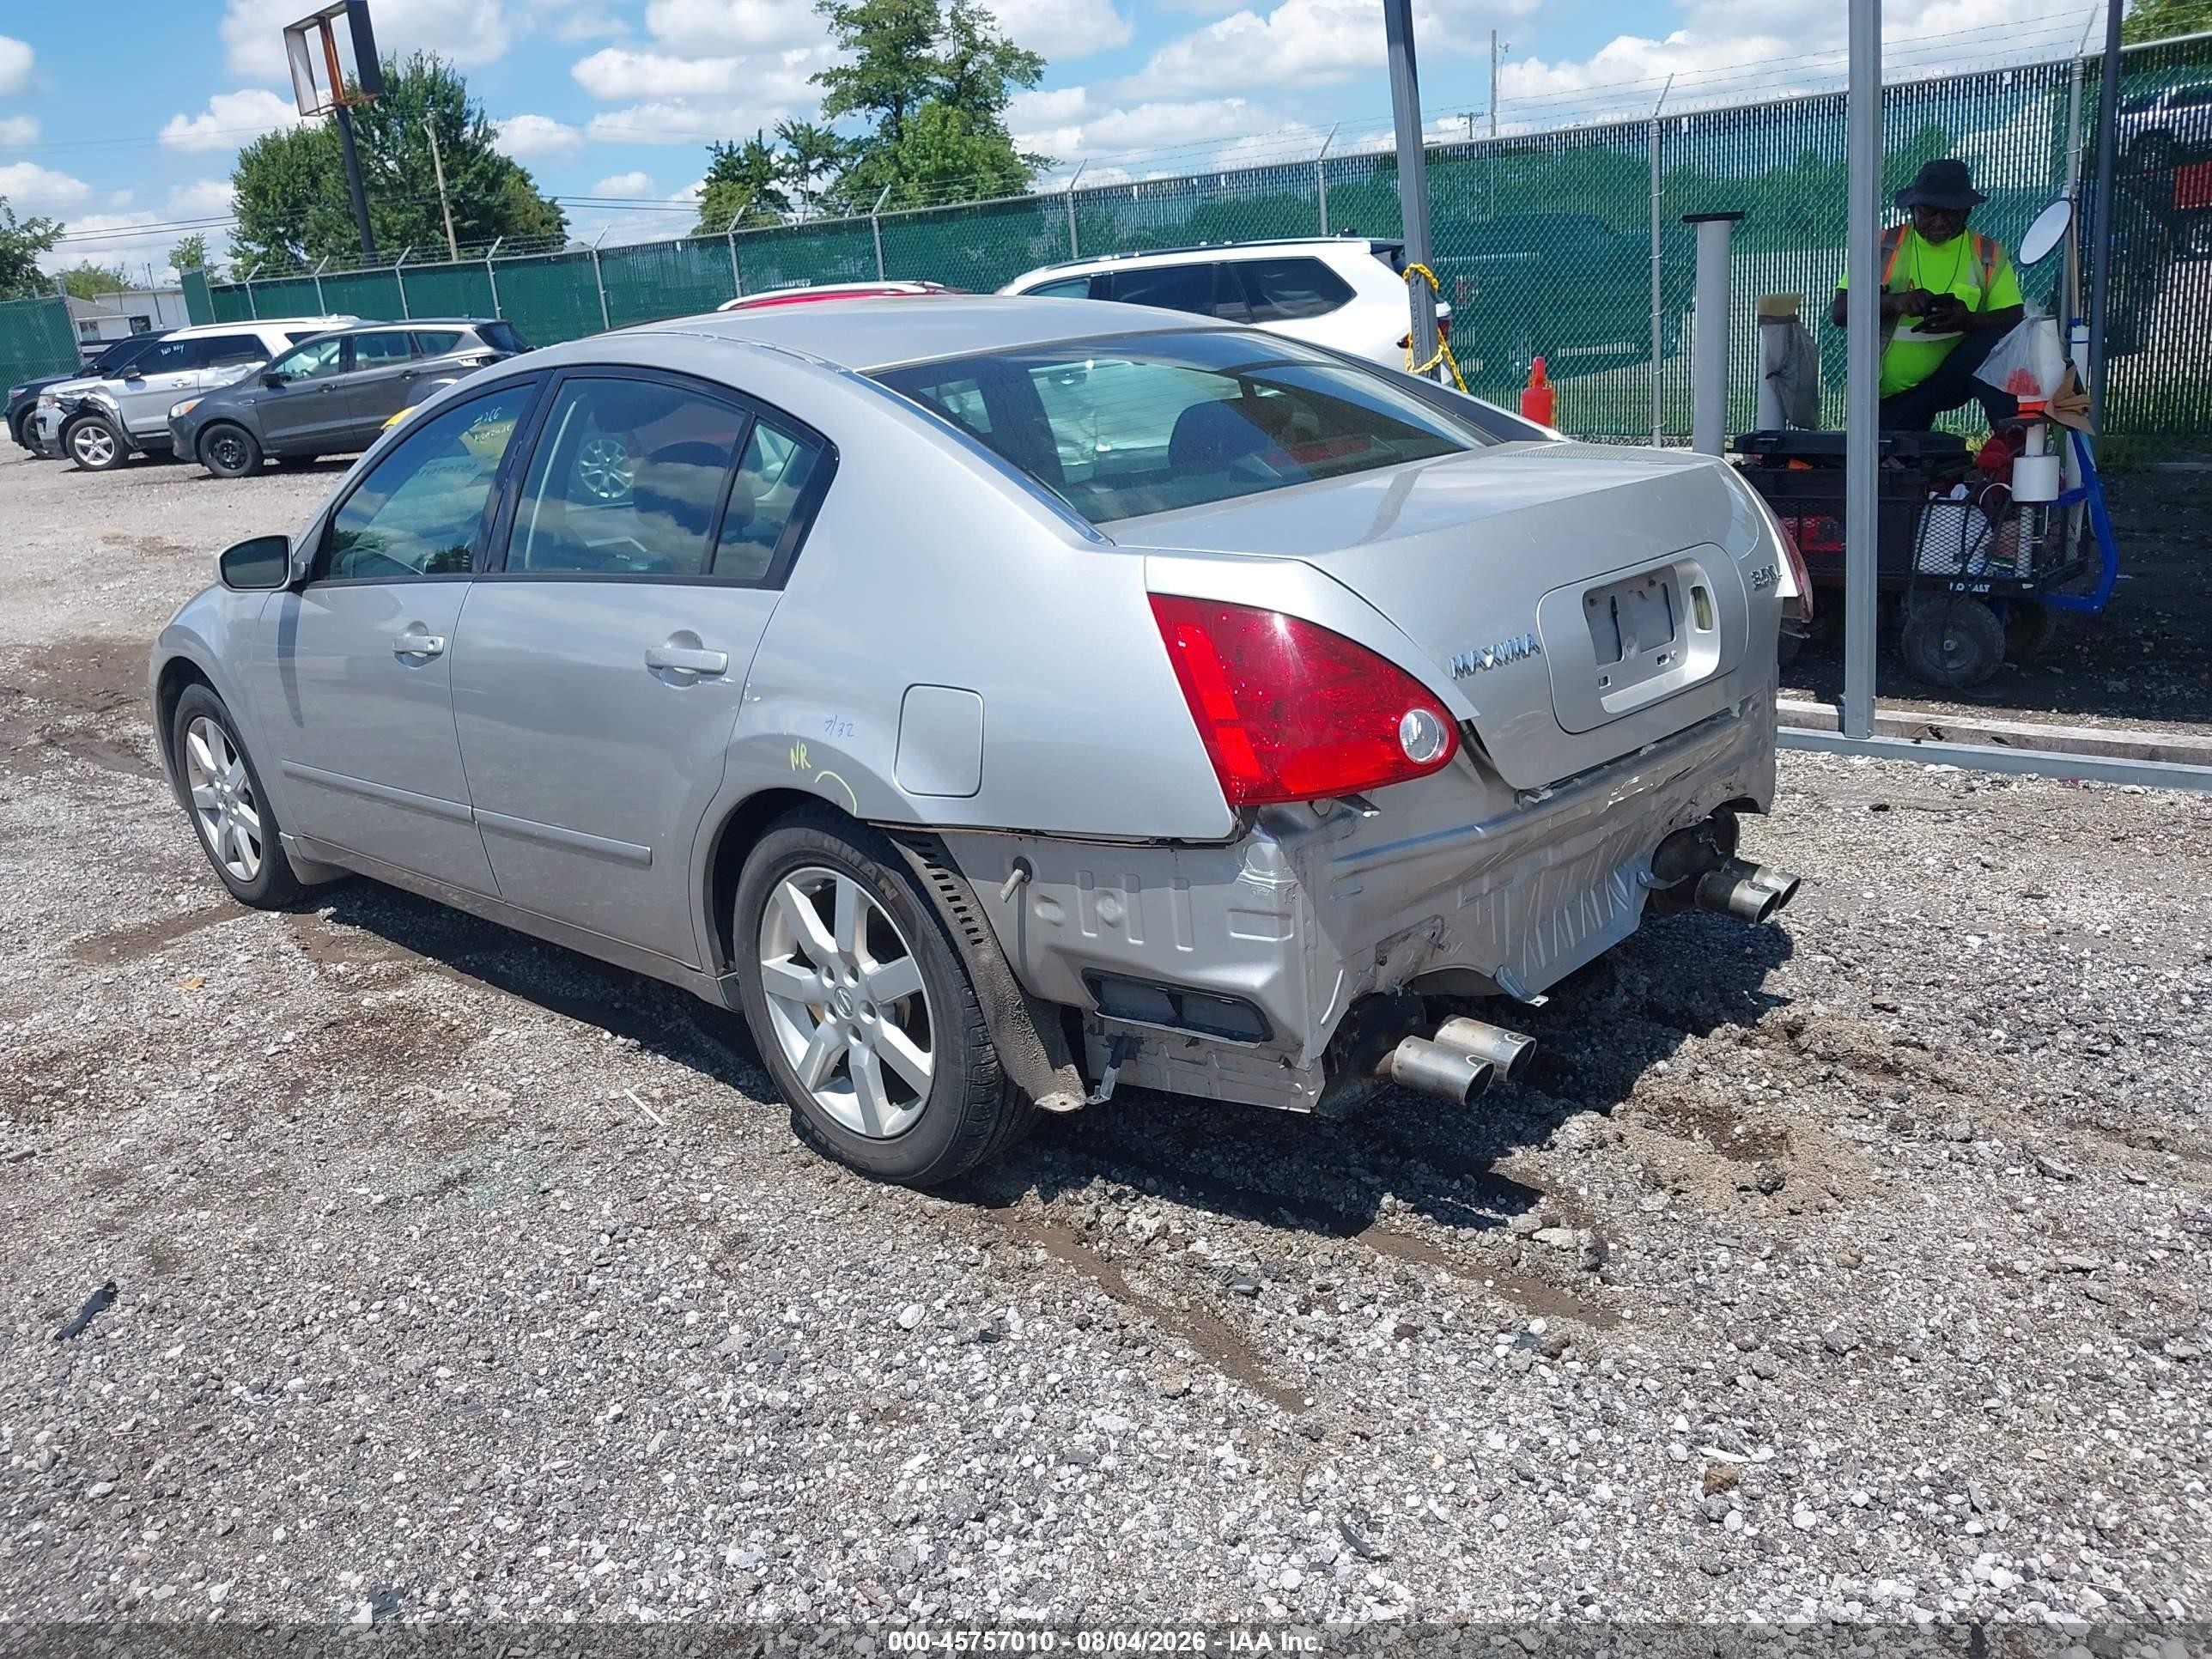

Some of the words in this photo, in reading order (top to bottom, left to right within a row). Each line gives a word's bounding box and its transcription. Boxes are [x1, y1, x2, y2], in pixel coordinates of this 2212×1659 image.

[1949, 582, 1990, 592] OALT
[1449, 634, 1541, 680] MAXIMA
[790, 738, 811, 771] NR
